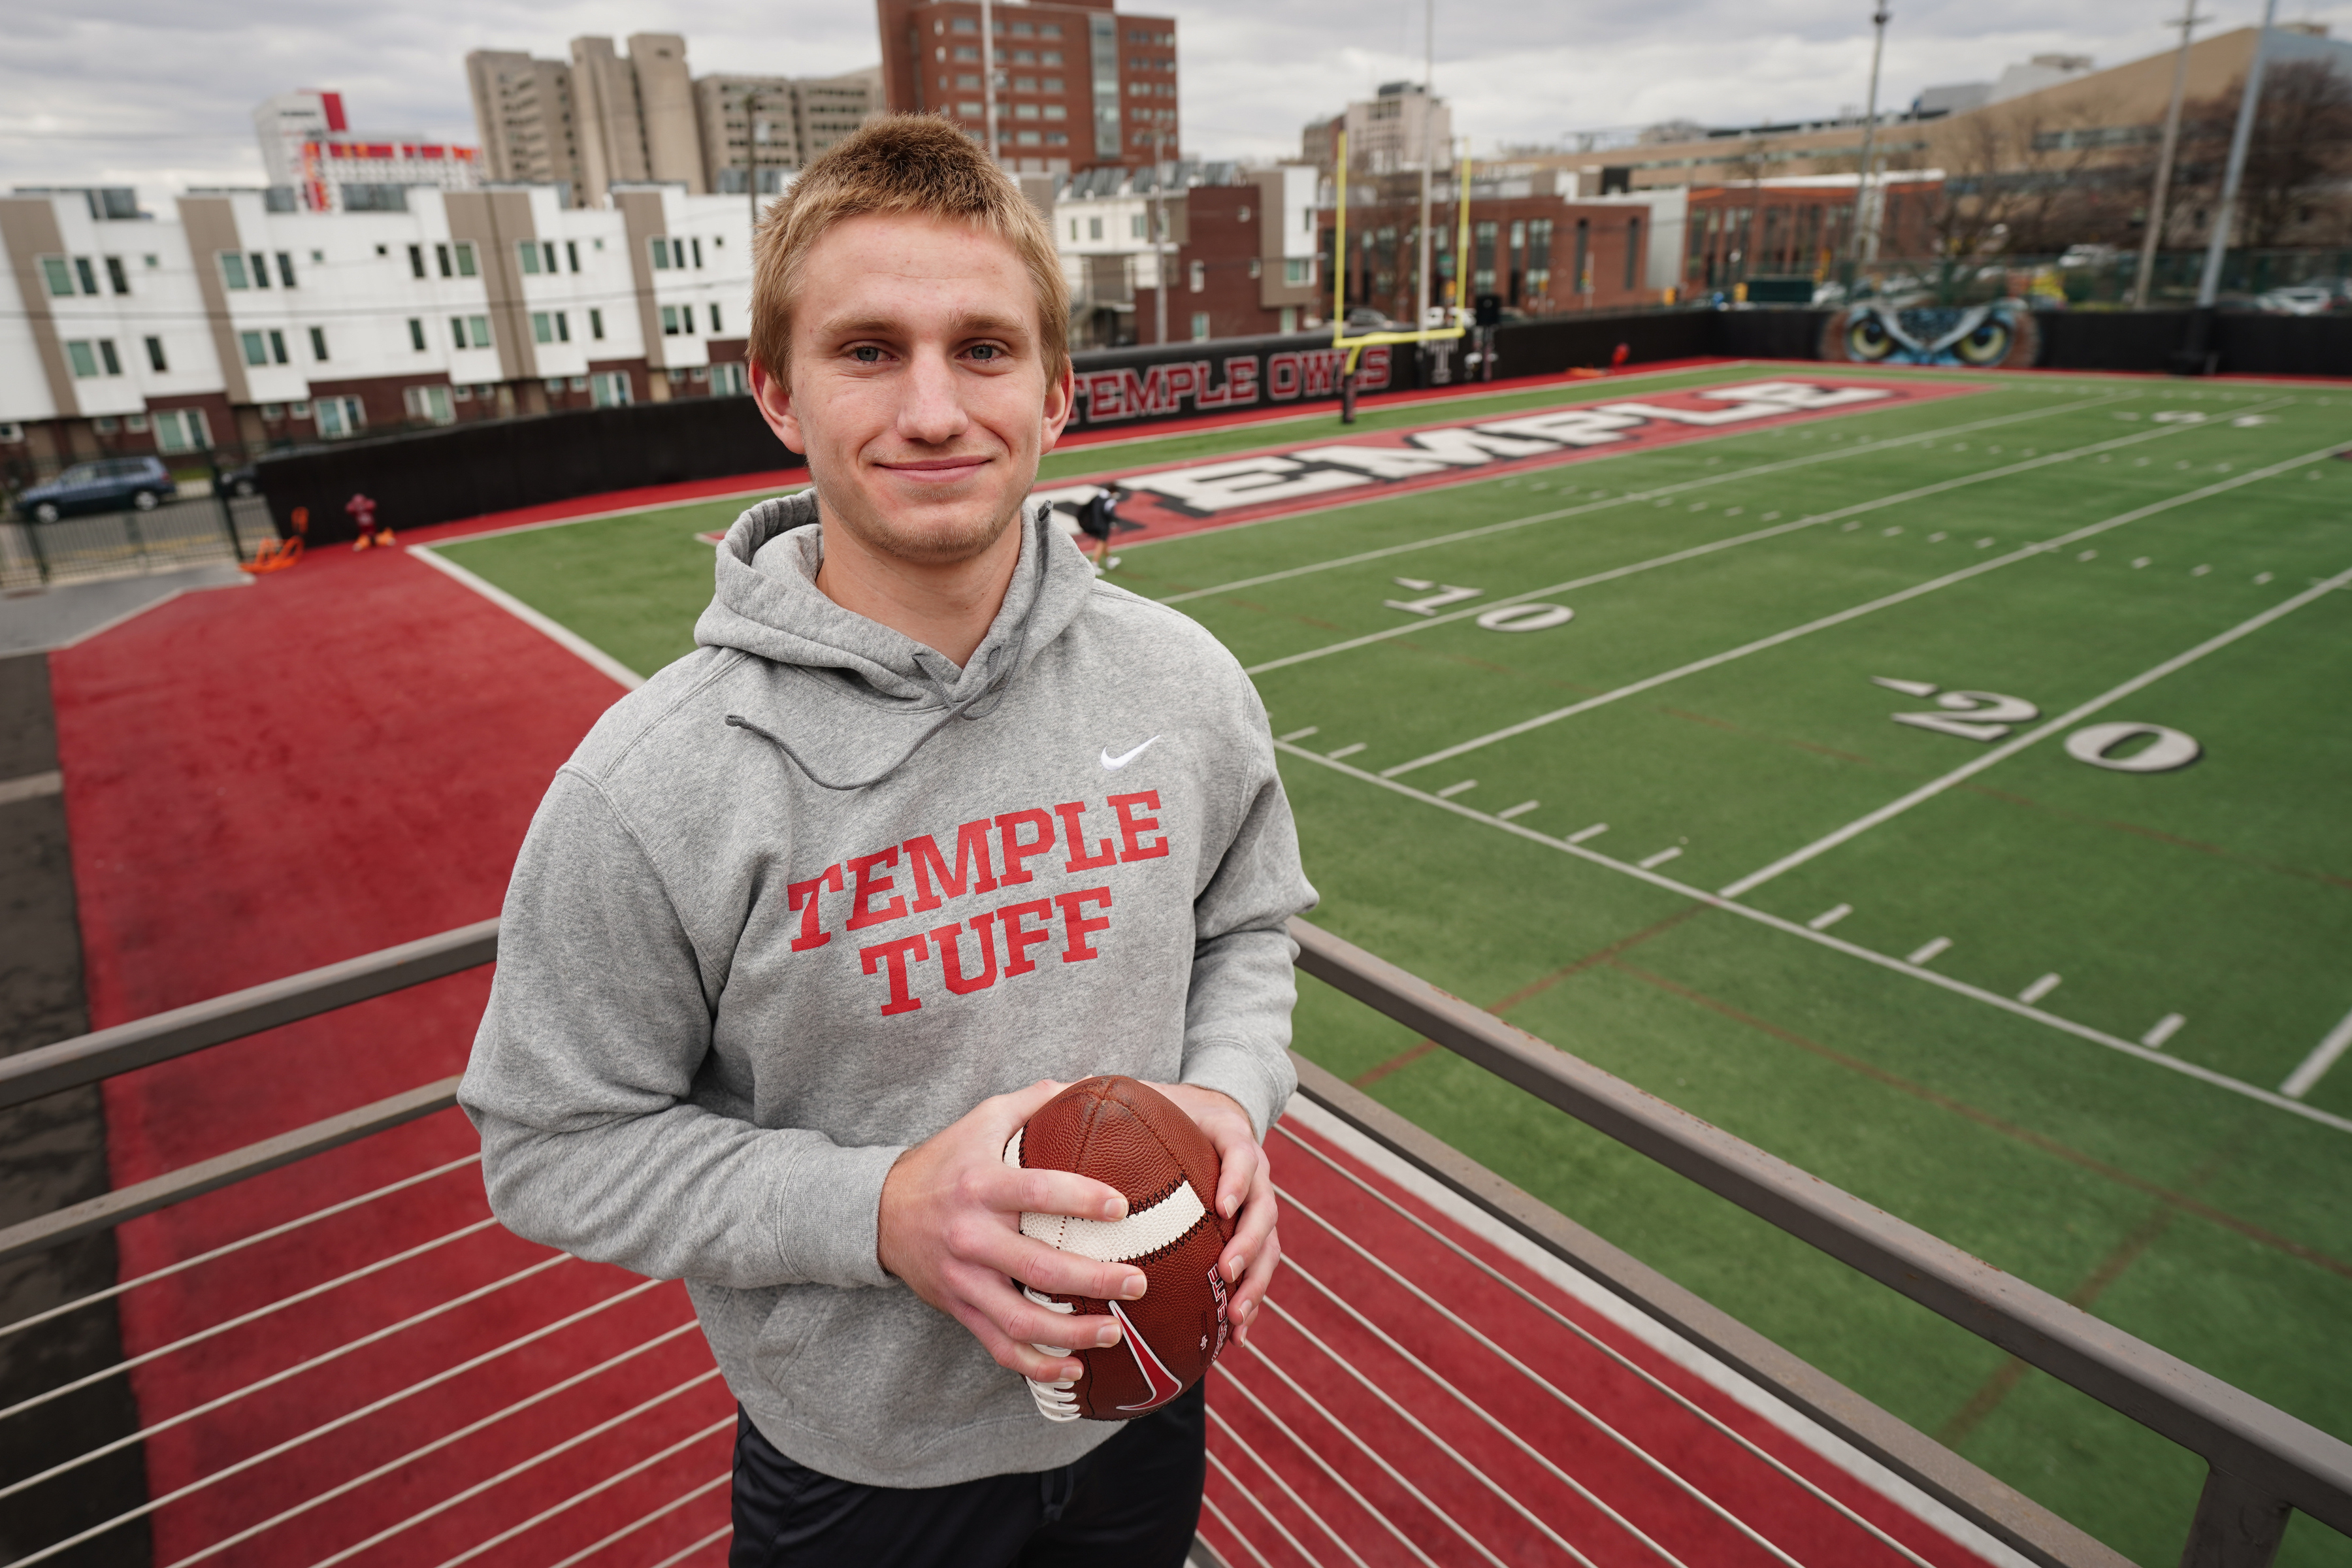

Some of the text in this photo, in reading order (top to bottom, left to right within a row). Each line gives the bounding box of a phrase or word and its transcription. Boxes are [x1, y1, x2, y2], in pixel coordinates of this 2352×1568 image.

[787, 789, 1169, 953] TEMPLE
[859, 886, 1113, 1017] TUFF
[1207, 1262, 1228, 1323] ELITE
